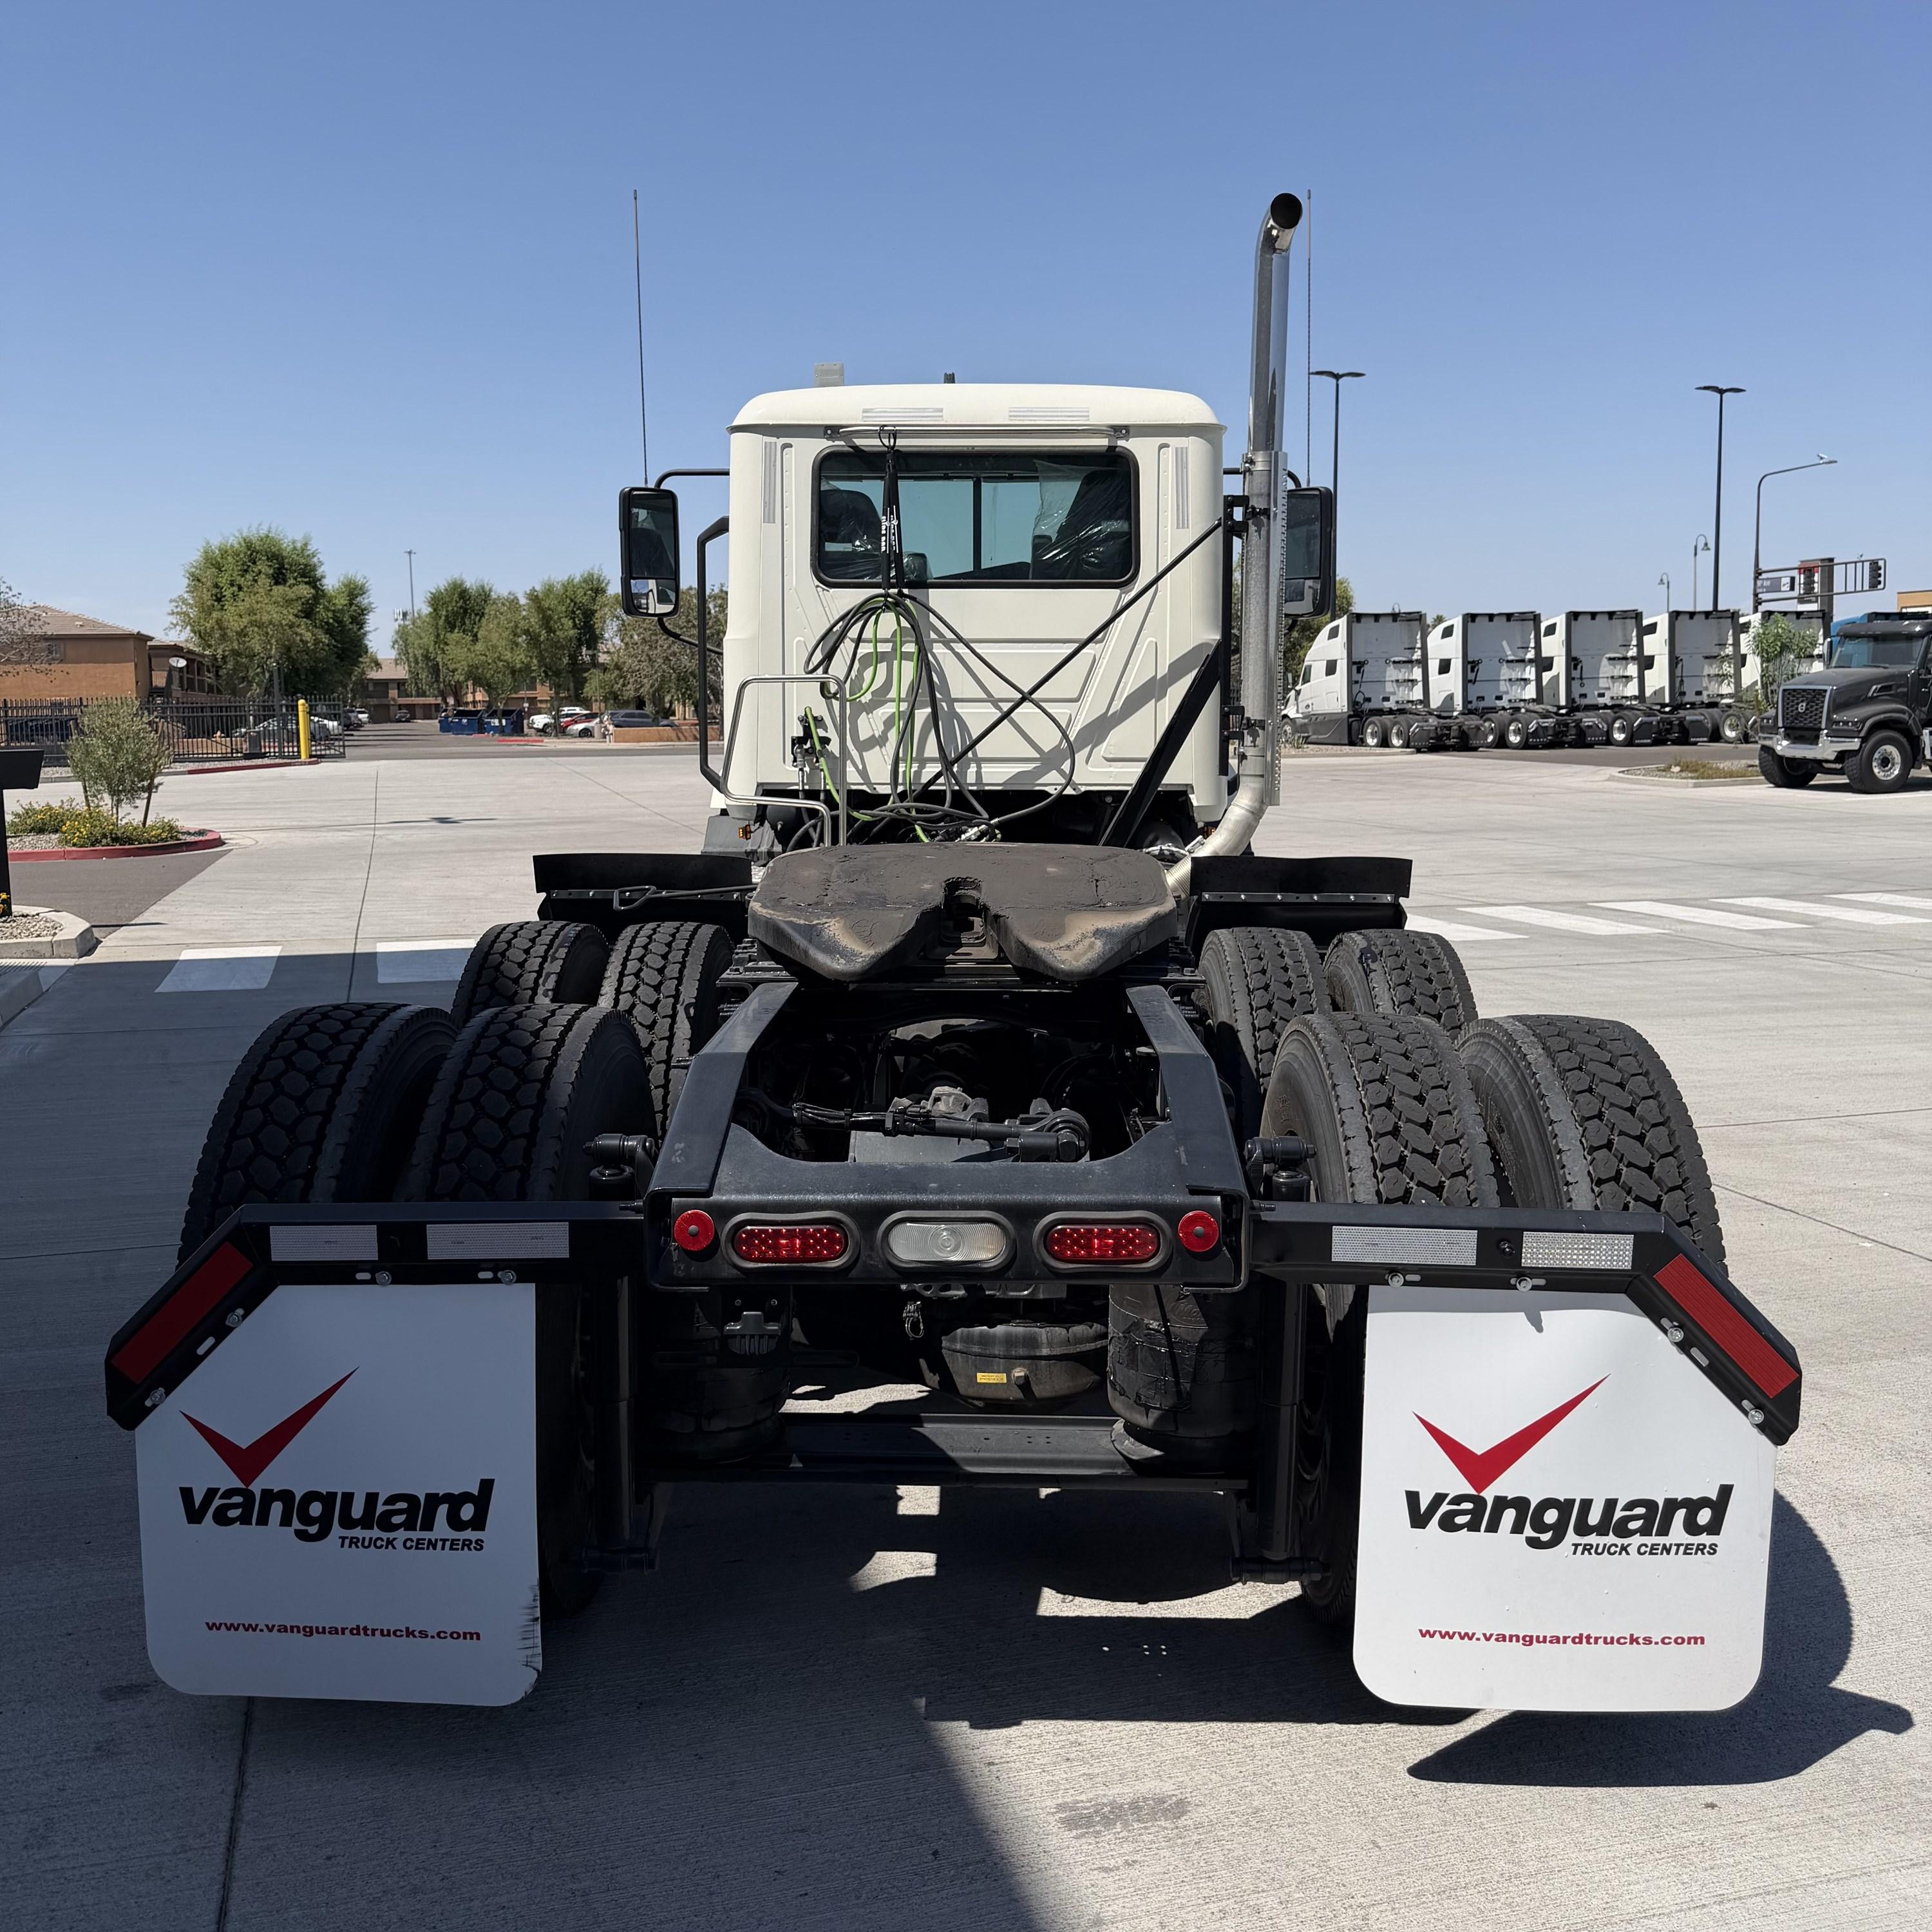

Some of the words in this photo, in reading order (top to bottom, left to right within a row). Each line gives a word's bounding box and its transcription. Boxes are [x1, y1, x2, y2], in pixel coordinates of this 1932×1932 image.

[178, 1478, 495, 1542] vanguard
[1404, 1484, 1735, 1550] vanguard
[338, 1535, 397, 1551] TRUCK
[402, 1537, 485, 1552] CENTERS
[1571, 1542, 1633, 1556] TRUCK
[1636, 1542, 1718, 1557] CENTERS
[205, 1620, 482, 1642] www.vanguardtrucks.com
[1417, 1627, 1706, 1647] www.vanguardtrucks.com
